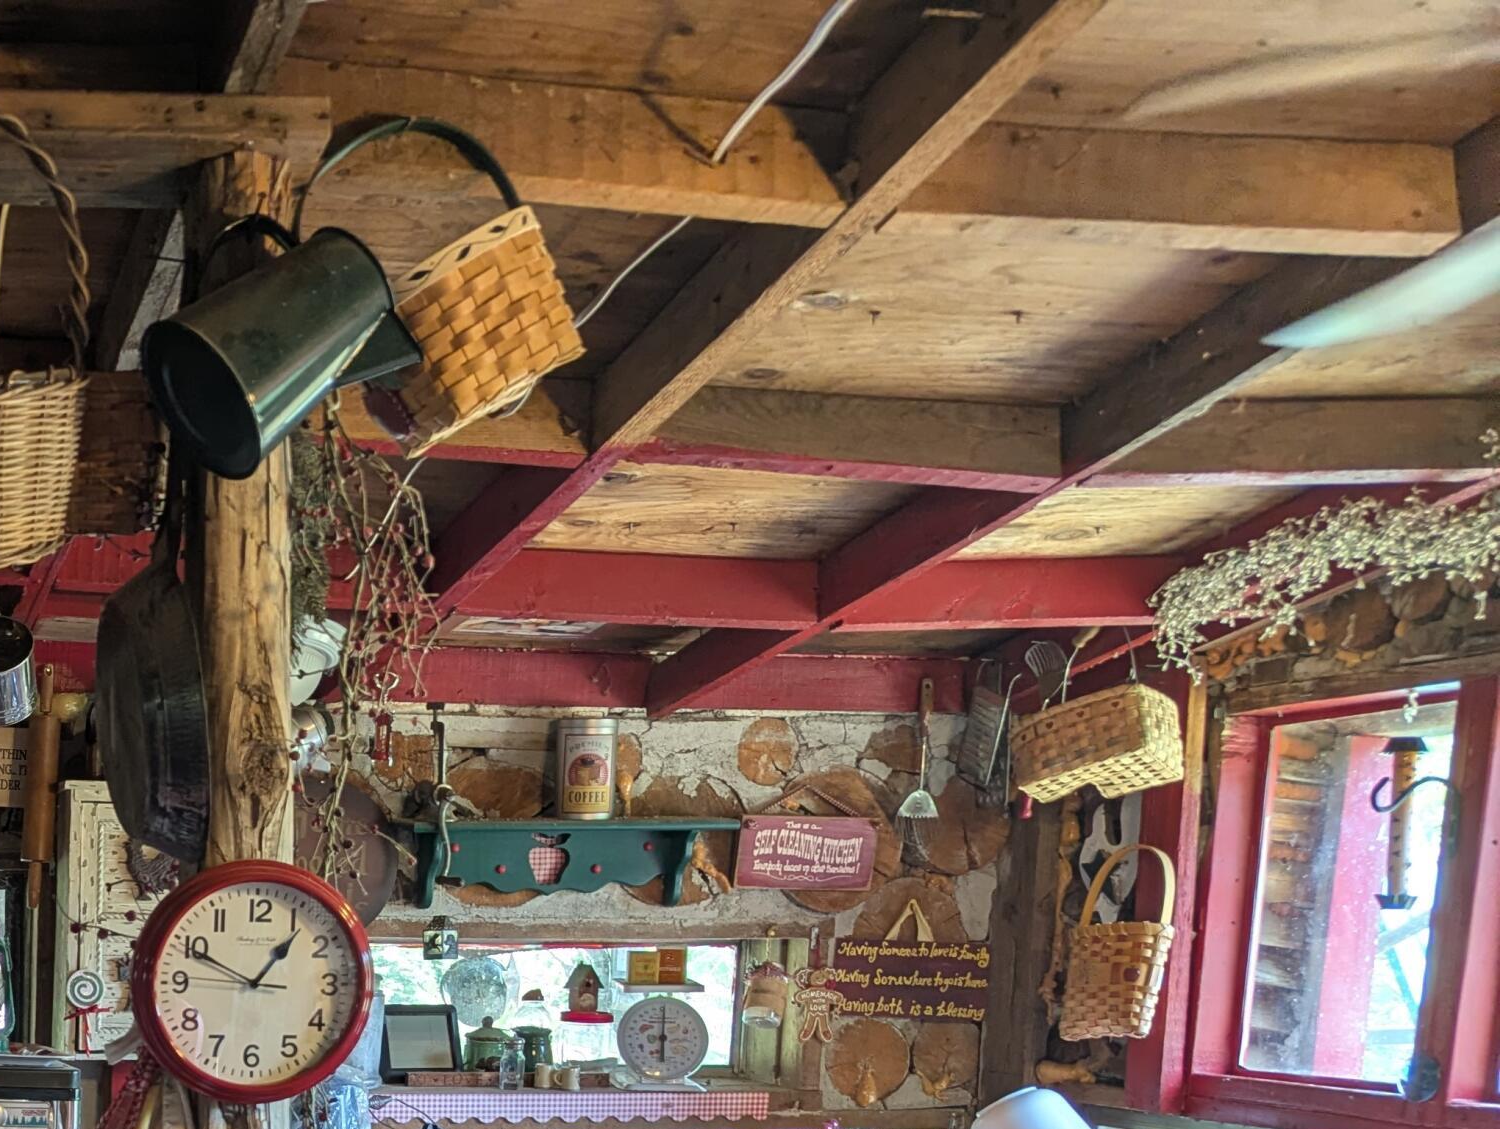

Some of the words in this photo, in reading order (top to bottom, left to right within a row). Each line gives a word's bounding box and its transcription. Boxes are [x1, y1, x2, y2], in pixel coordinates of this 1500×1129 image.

[568, 790, 606, 804] COFFEE
[753, 829, 779, 857] SELF
[777, 828, 822, 861] CLEANING
[820, 836, 864, 864] KITCHEN
[214, 908, 226, 933] 11
[249, 899, 272, 923] 12
[290, 908, 297, 932] 1
[184, 935, 209, 959] 10
[311, 935, 329, 958] 2
[837, 941, 879, 963] Having
[918, 942, 929, 957] to
[929, 943, 948, 958] love
[948, 944, 959, 958] is
[957, 944, 991, 968] family
[172, 970, 189, 994] 9
[320, 972, 339, 996] 3
[835, 968, 871, 988] Having
[873, 968, 933, 987] Somewhere
[933, 971, 943, 987] to
[940, 977, 952, 993] go
[952, 973, 964, 987] is
[800, 990, 838, 1001] HOMEMADE
[809, 1003, 827, 1011] LOVE
[181, 1008, 199, 1031] 8
[307, 1008, 326, 1032] 4
[875, 996, 905, 1016] both
[909, 1000, 922, 1017] is
[923, 1004, 934, 1017] a
[936, 1001, 986, 1021] blessing
[208, 1034, 226, 1058] 7
[242, 1044, 260, 1068] 6
[280, 1035, 299, 1058] 5
